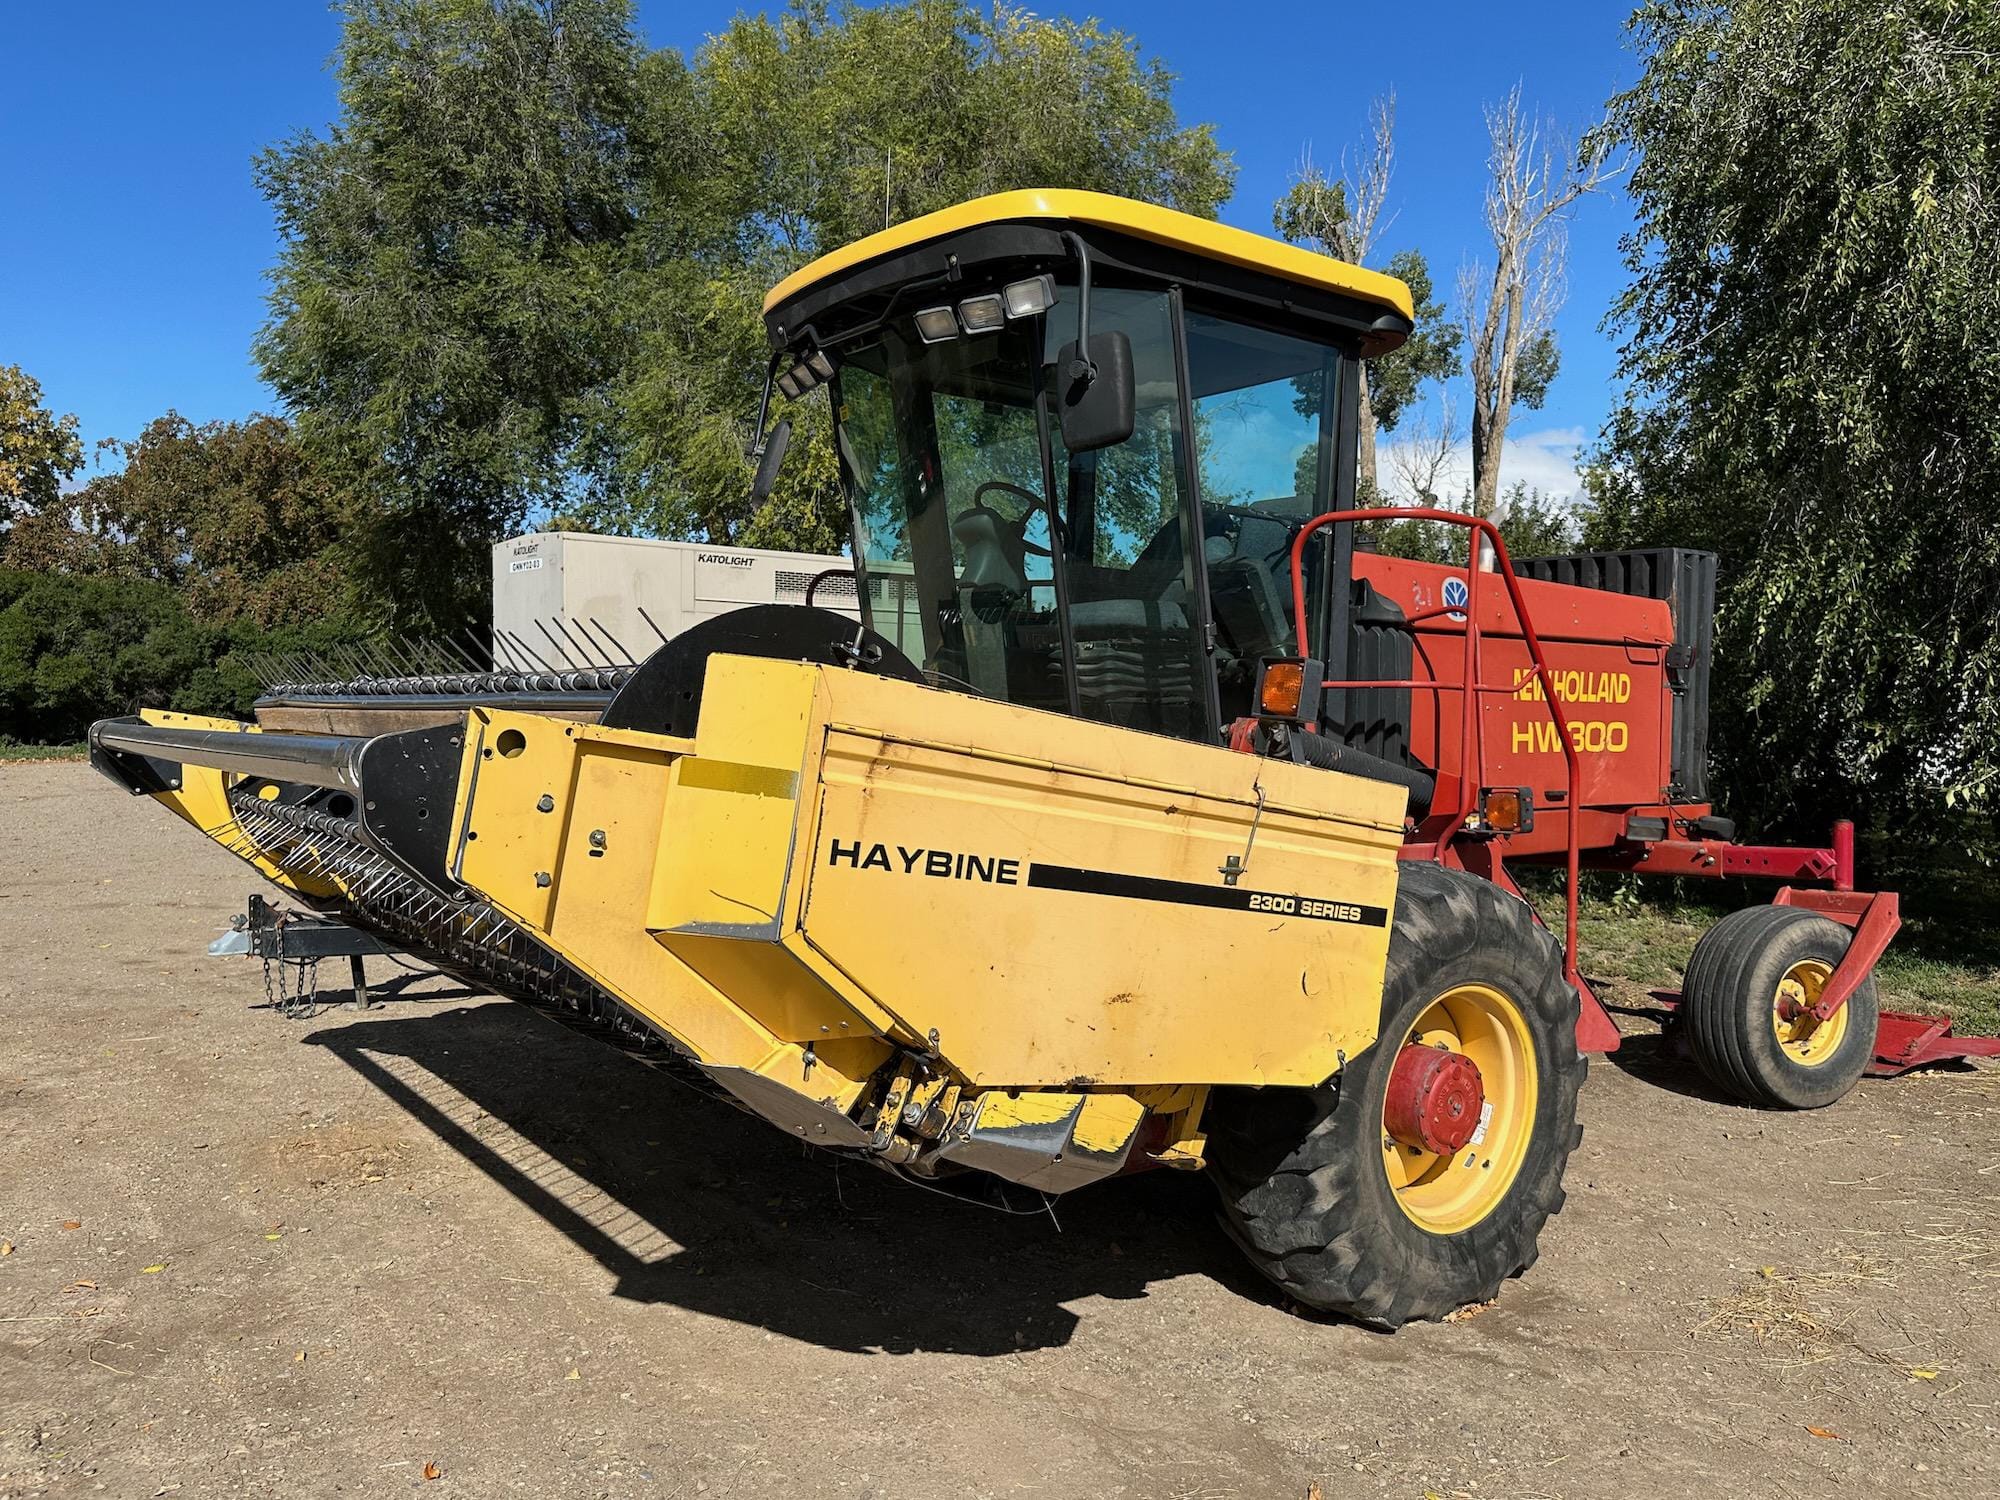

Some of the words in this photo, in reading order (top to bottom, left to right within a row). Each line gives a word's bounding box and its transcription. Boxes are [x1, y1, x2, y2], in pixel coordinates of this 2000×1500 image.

[698, 553, 756, 567] KATOLIGHT
[1553, 670, 1631, 703] HOLLAND
[1511, 721, 1628, 753] HW300
[829, 838, 1020, 885] HAYBINE
[1249, 894, 1296, 913] 2300
[1300, 900, 1362, 921] SERIES
